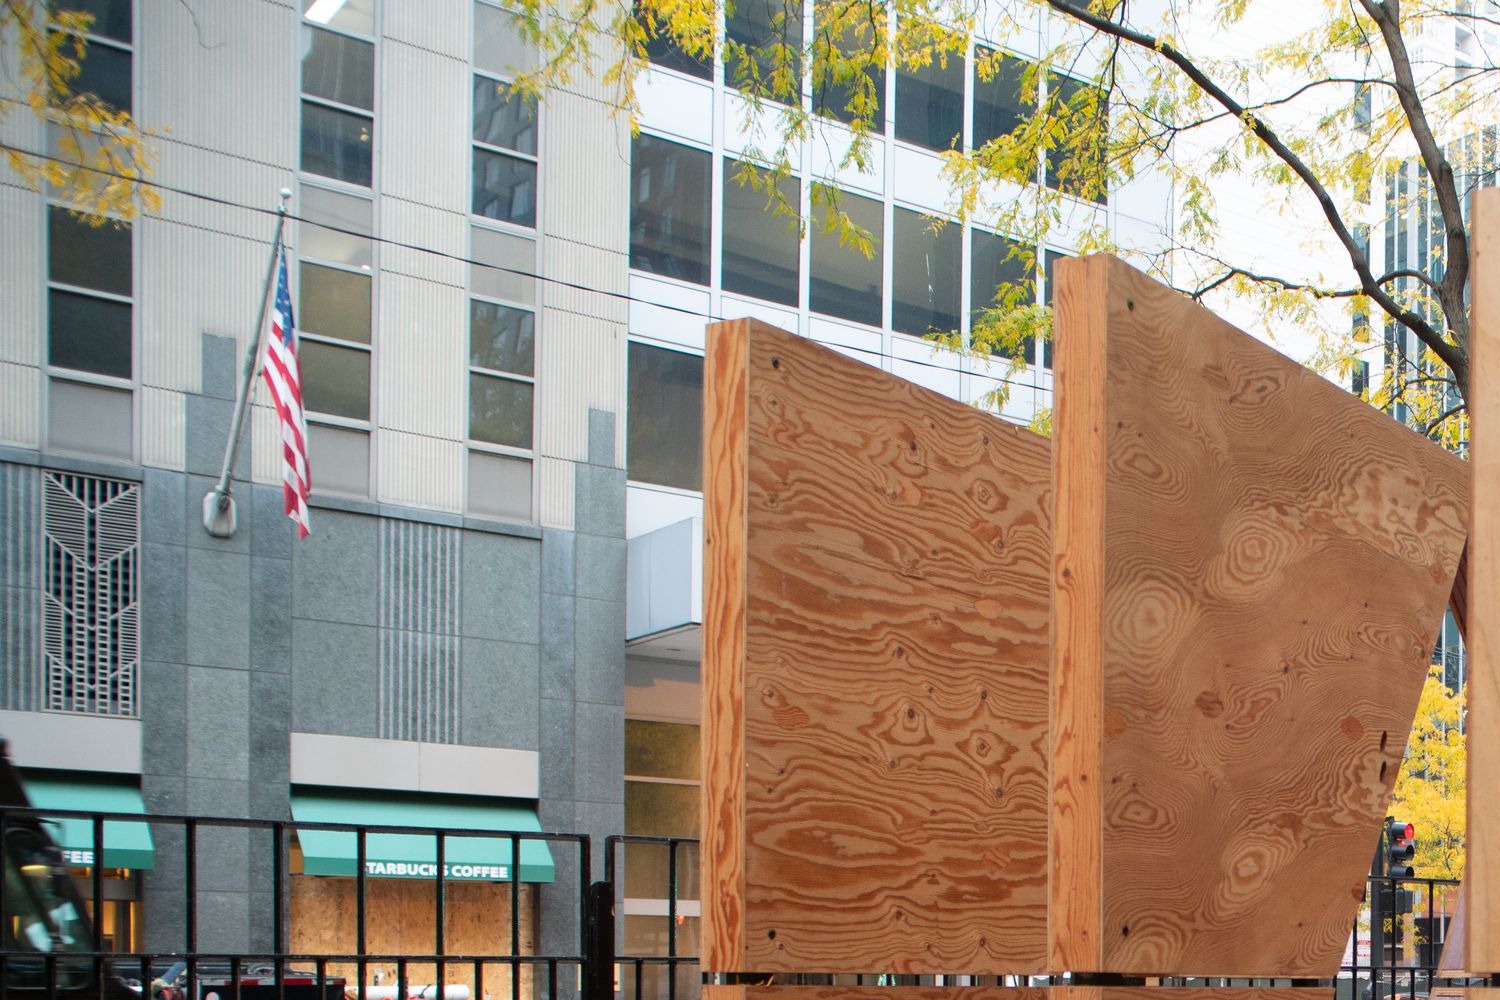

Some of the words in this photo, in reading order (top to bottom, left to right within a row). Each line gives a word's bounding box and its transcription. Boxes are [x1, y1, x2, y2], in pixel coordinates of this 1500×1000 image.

[61, 850, 95, 864] FEE
[365, 862, 448, 877] TARBUCKS
[451, 865, 509, 878] COFFEE
